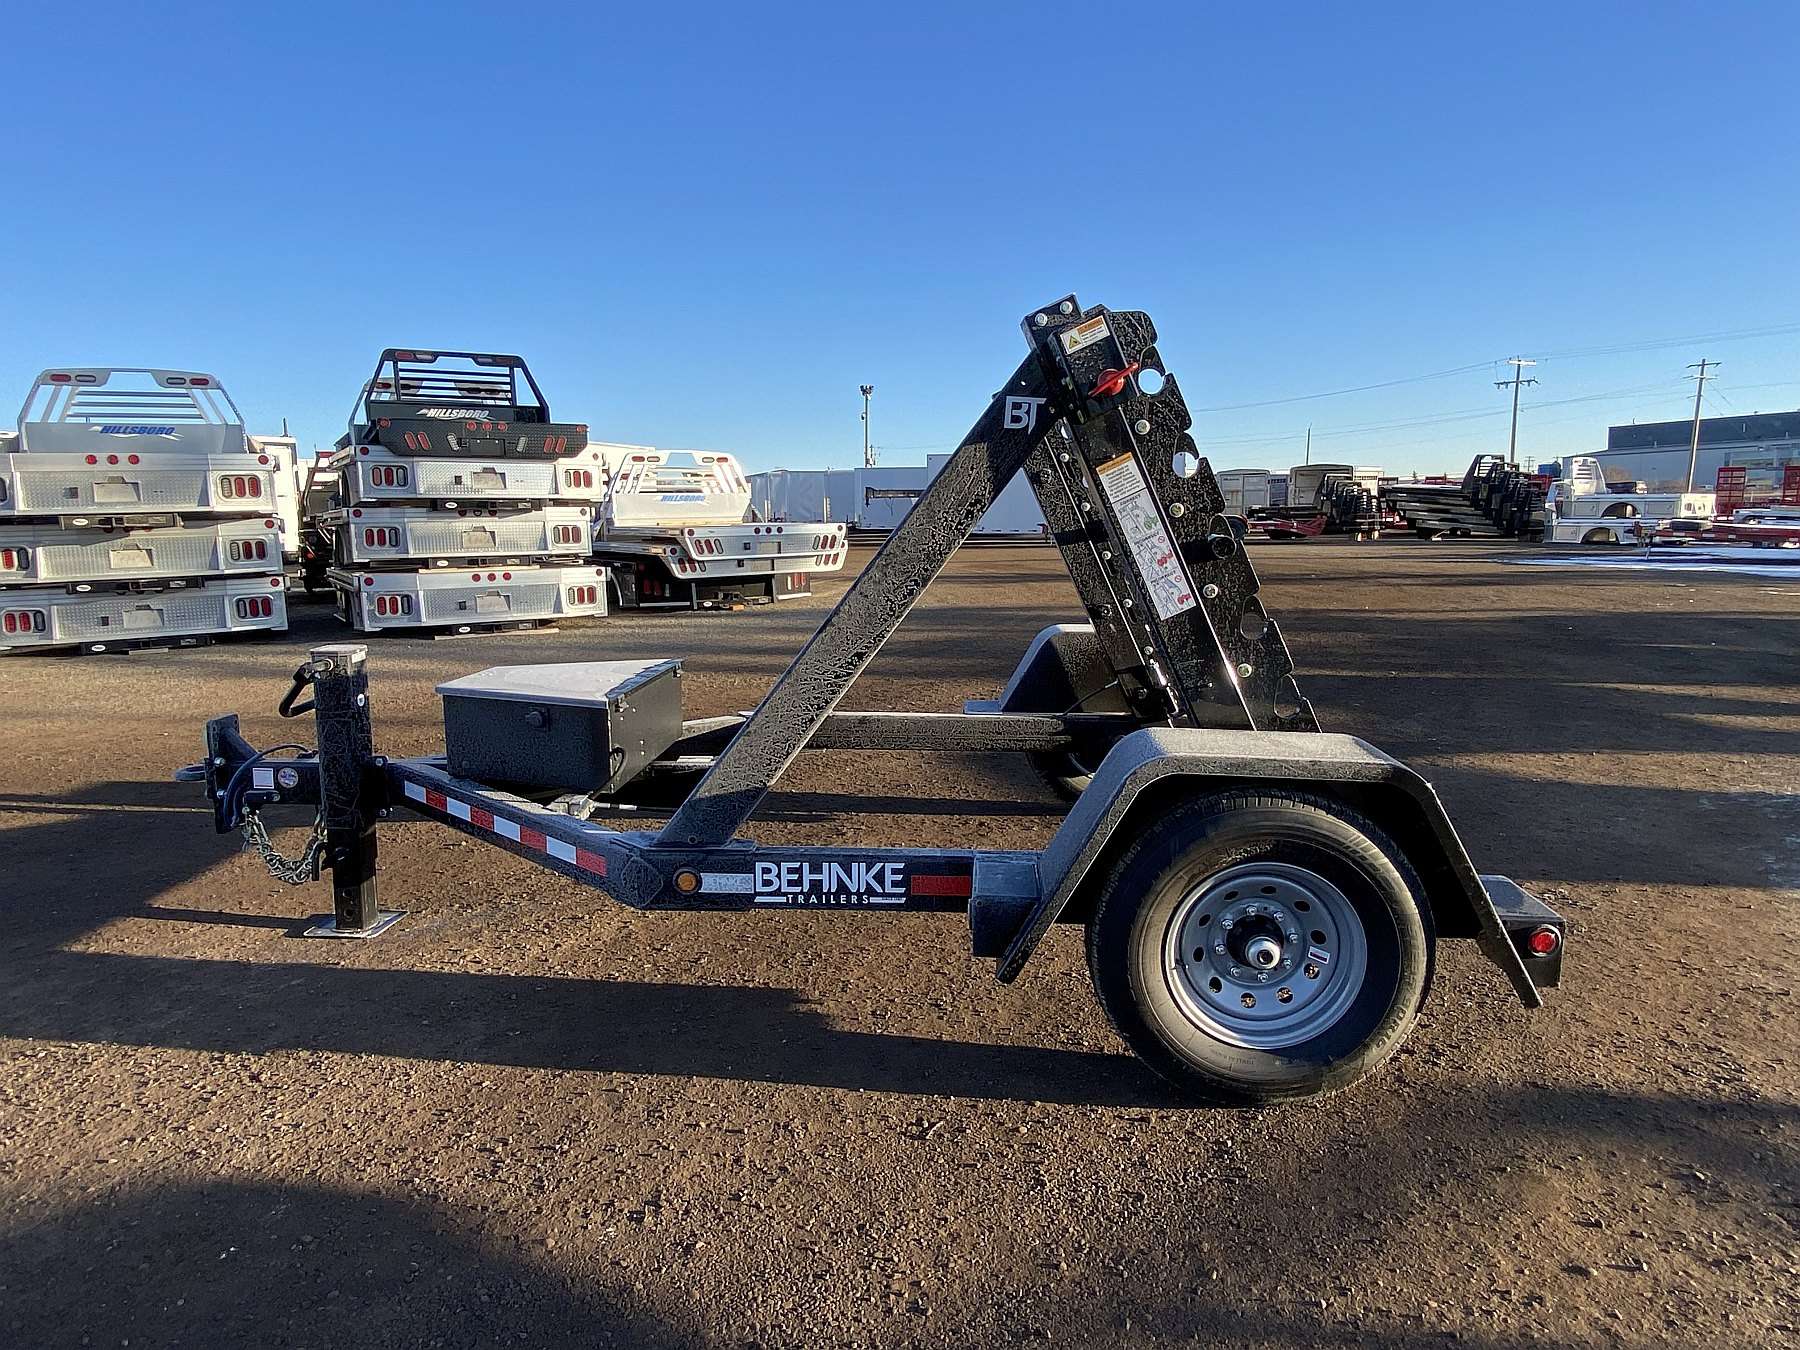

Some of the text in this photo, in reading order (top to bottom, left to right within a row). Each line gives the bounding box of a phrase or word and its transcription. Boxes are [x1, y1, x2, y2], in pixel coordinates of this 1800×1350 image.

[427, 408, 490, 419] HILLSBORO
[1004, 396, 1047, 435] BT
[100, 425, 176, 435] HILLSBORO
[755, 862, 906, 893] BEHNKE
[787, 895, 869, 904] TRAILERS
